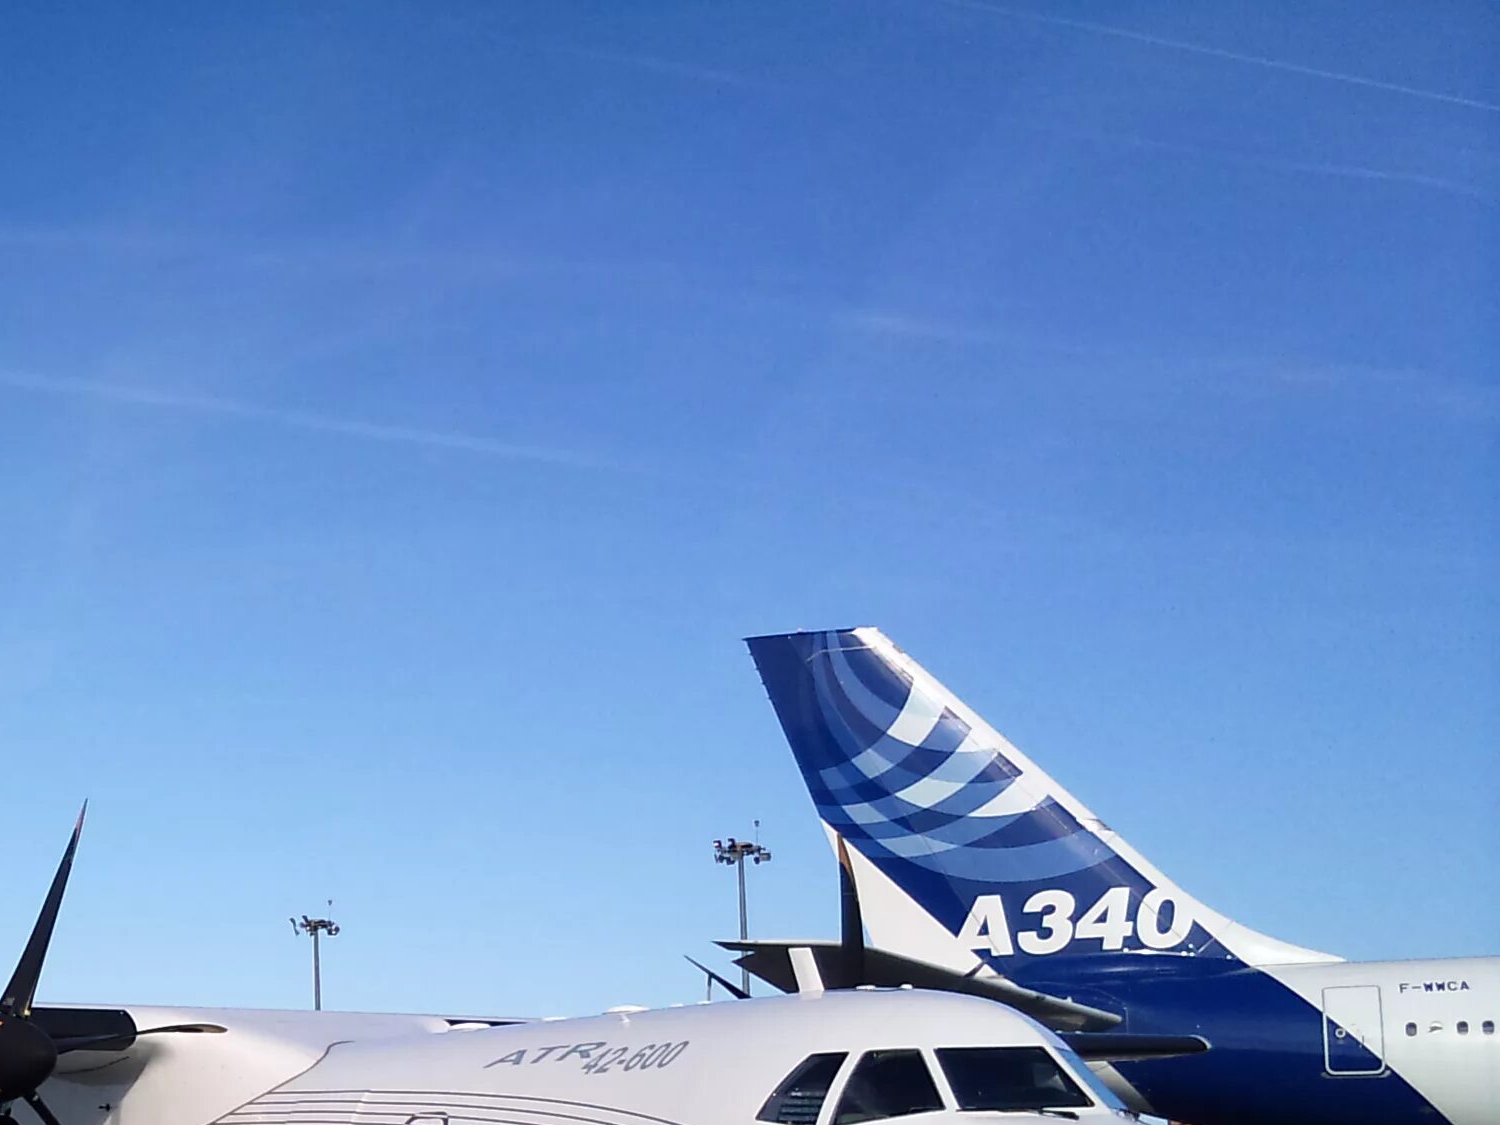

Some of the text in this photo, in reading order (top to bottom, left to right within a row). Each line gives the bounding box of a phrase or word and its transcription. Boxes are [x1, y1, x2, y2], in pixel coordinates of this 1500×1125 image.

[954, 886, 1195, 957] A340
[1398, 981, 1470, 994] F-WWCA
[483, 1040, 690, 1075] ATR 42-600
